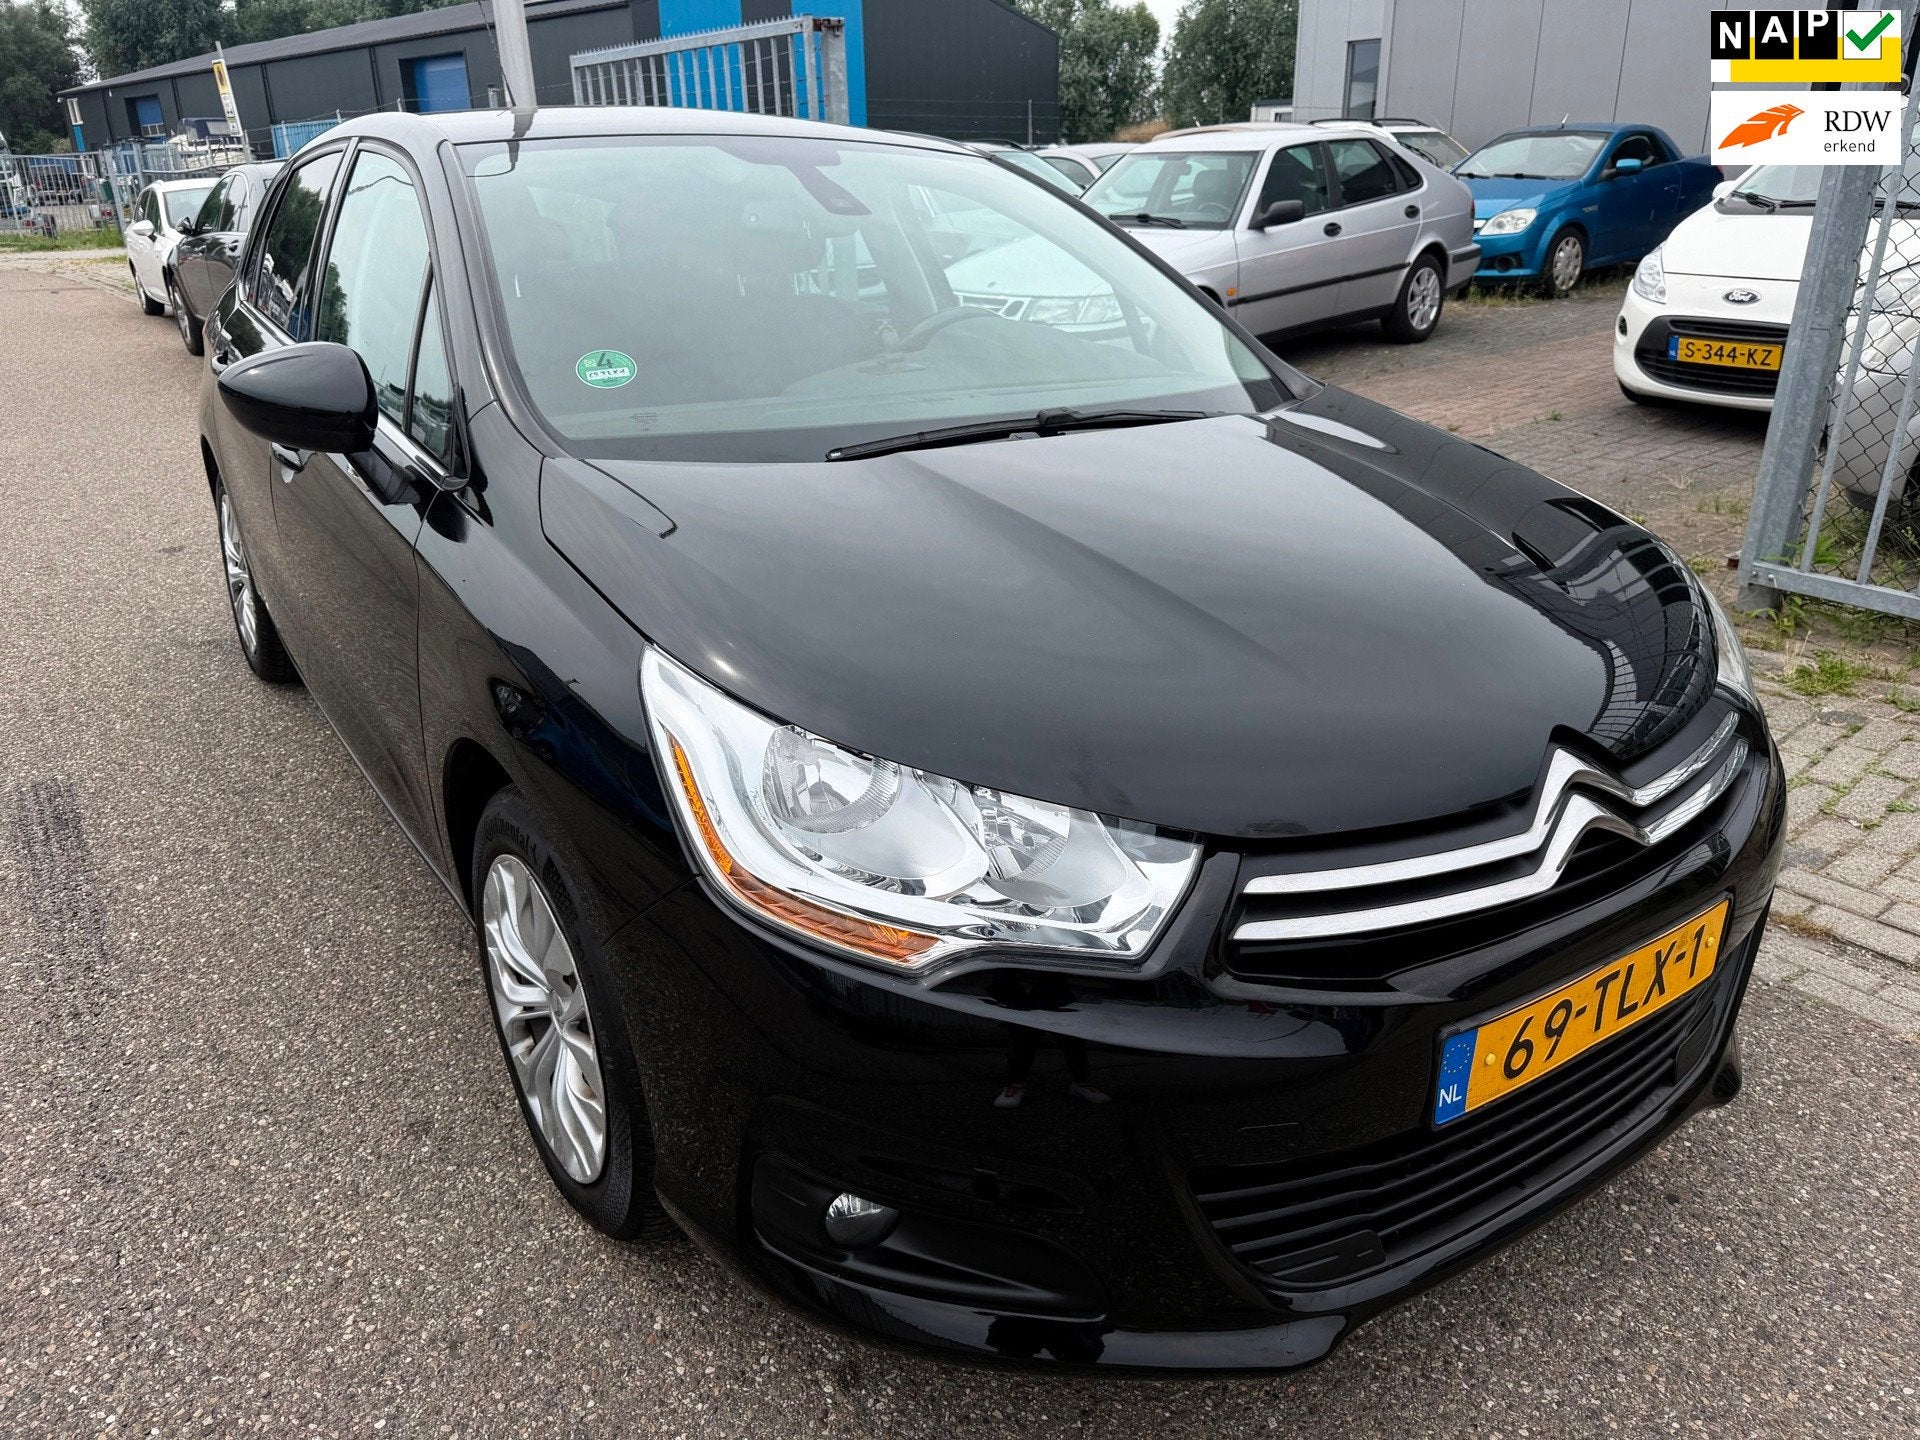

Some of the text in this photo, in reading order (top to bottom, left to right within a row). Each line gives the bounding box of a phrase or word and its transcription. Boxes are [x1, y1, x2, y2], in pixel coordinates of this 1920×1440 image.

[1728, 290, 1753, 302] Ford
[597, 353, 614, 368] 4
[1684, 341, 1774, 367] S-344-KZ
[484, 812, 530, 855] Continental
[1502, 923, 1706, 1080] 69-TLX-1
[1438, 1083, 1462, 1108] NL
